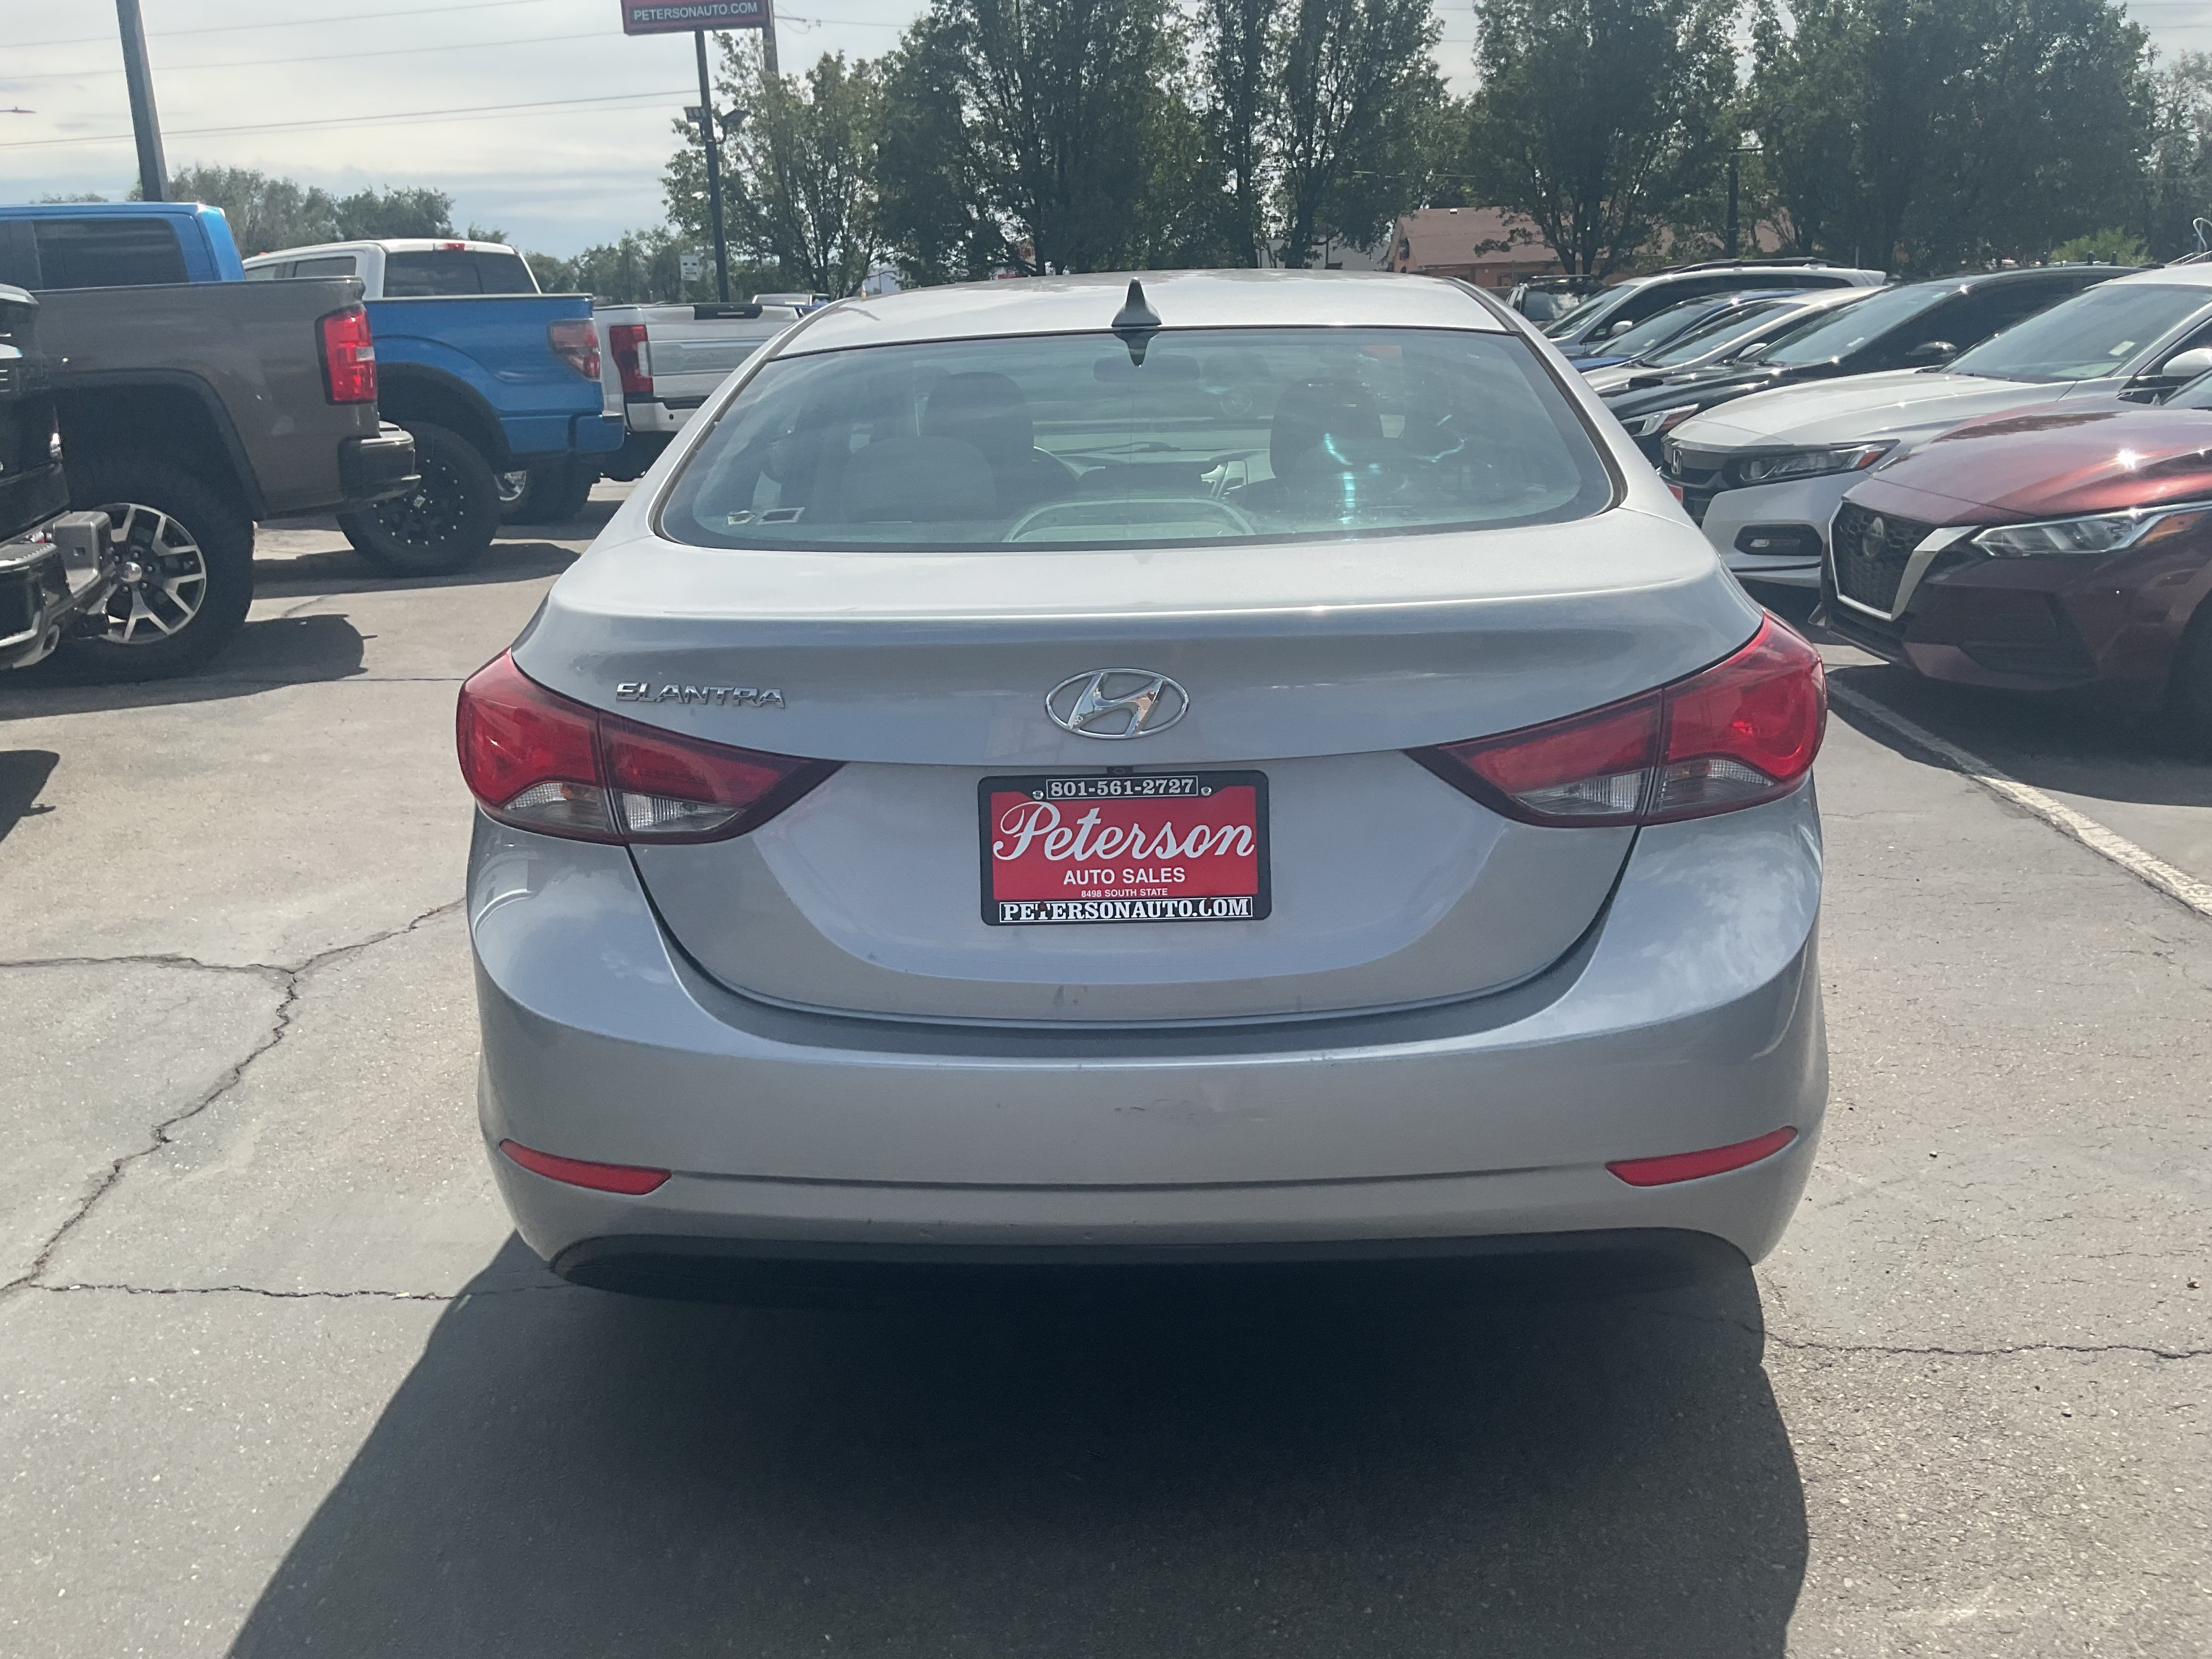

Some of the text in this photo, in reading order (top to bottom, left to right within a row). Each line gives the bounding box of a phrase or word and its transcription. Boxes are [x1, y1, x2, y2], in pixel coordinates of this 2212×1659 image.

[634, 2, 758, 20] PETERSONAUTO.COM
[616, 681, 786, 708] ELANTRA
[1051, 778, 1194, 797] 801-561-2727
[993, 800, 1255, 861] Peterson
[1063, 867, 1186, 885] AUTO SALES
[1104, 889, 1137, 897] SOUTH
[1139, 888, 1168, 896] STATE
